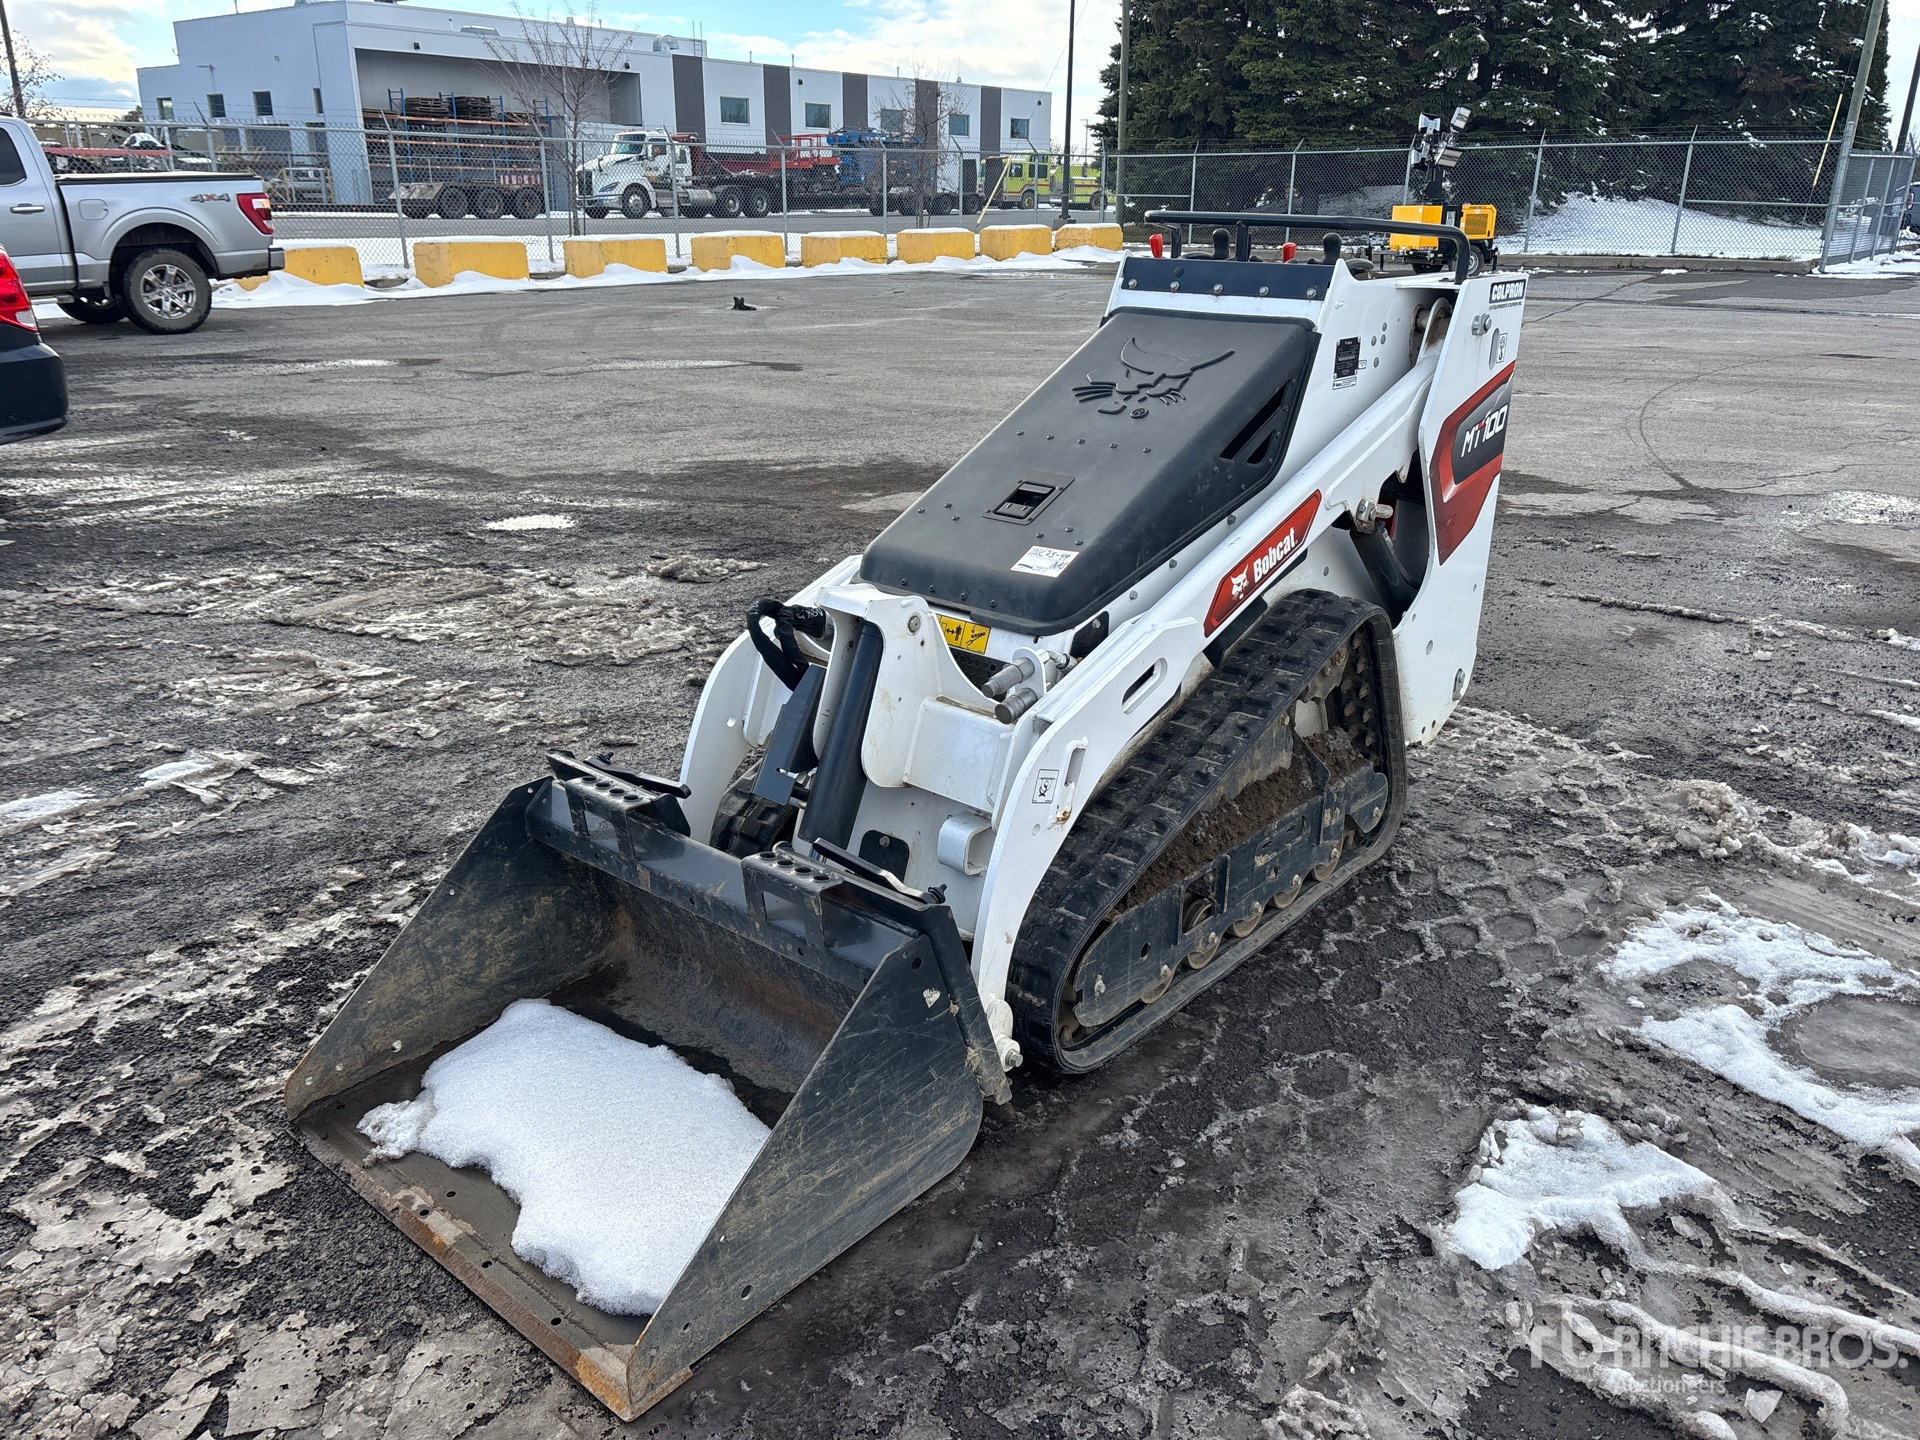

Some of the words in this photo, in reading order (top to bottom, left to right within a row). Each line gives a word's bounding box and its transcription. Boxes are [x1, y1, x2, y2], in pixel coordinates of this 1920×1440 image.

[1492, 282, 1524, 301] COLPRON
[1461, 404, 1508, 458] MT100
[1253, 527, 1296, 583] Bobcat
